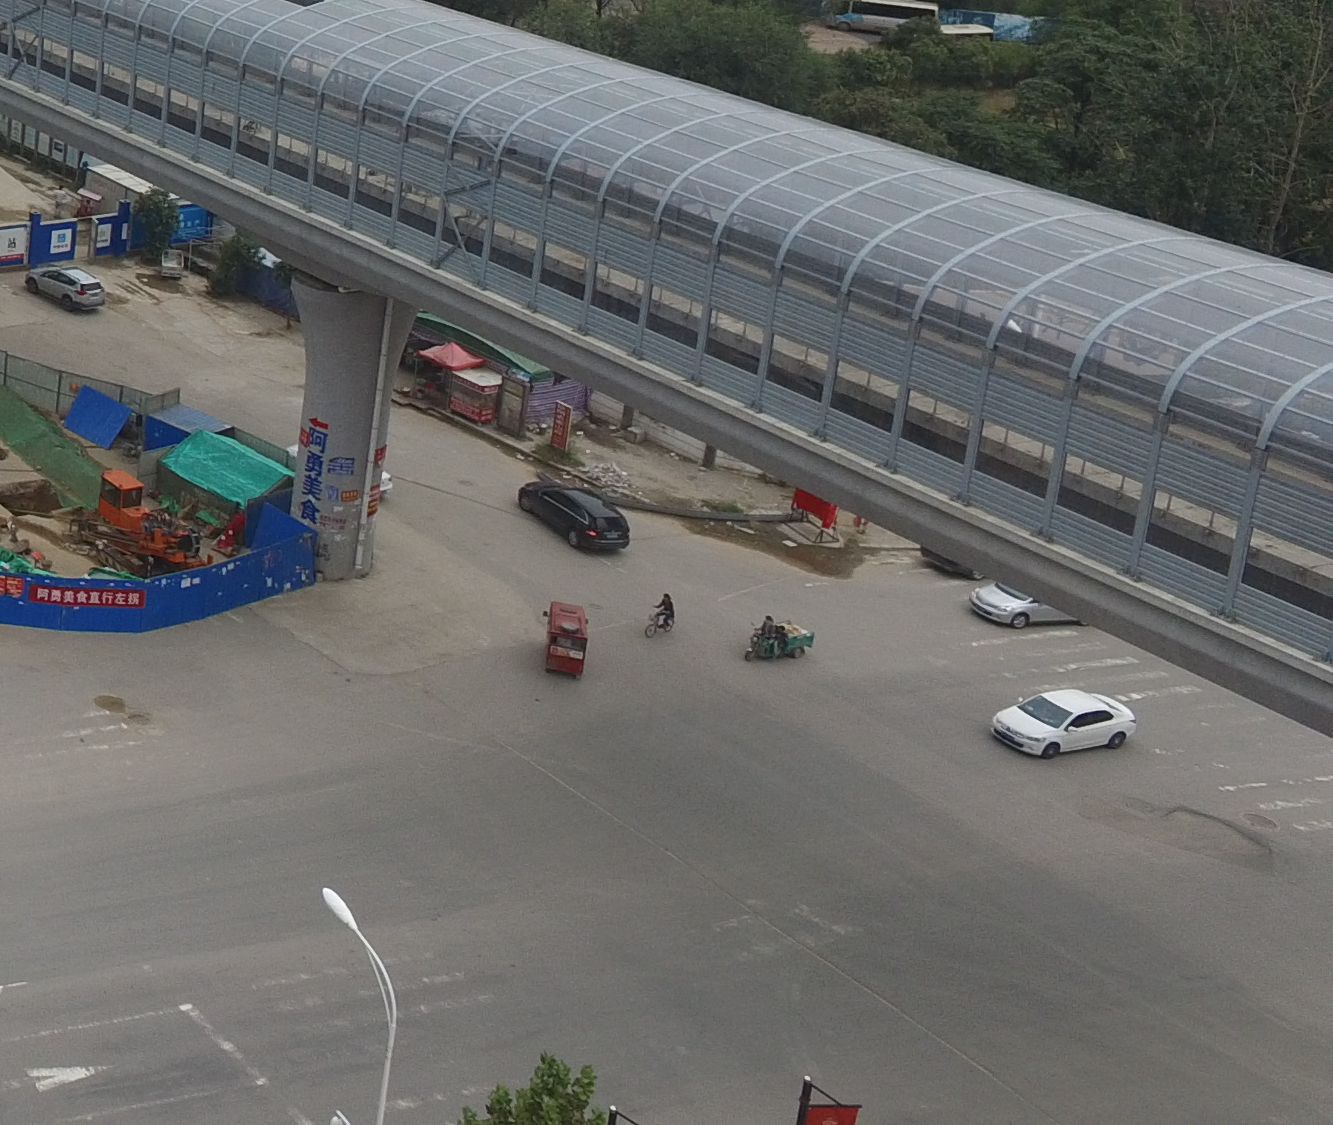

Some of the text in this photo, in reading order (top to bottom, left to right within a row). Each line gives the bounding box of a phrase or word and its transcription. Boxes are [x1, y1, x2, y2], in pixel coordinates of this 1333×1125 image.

[301, 426, 328, 525] 阿勇美食
[37, 587, 139, 605] 阿勇美食直行左拐
